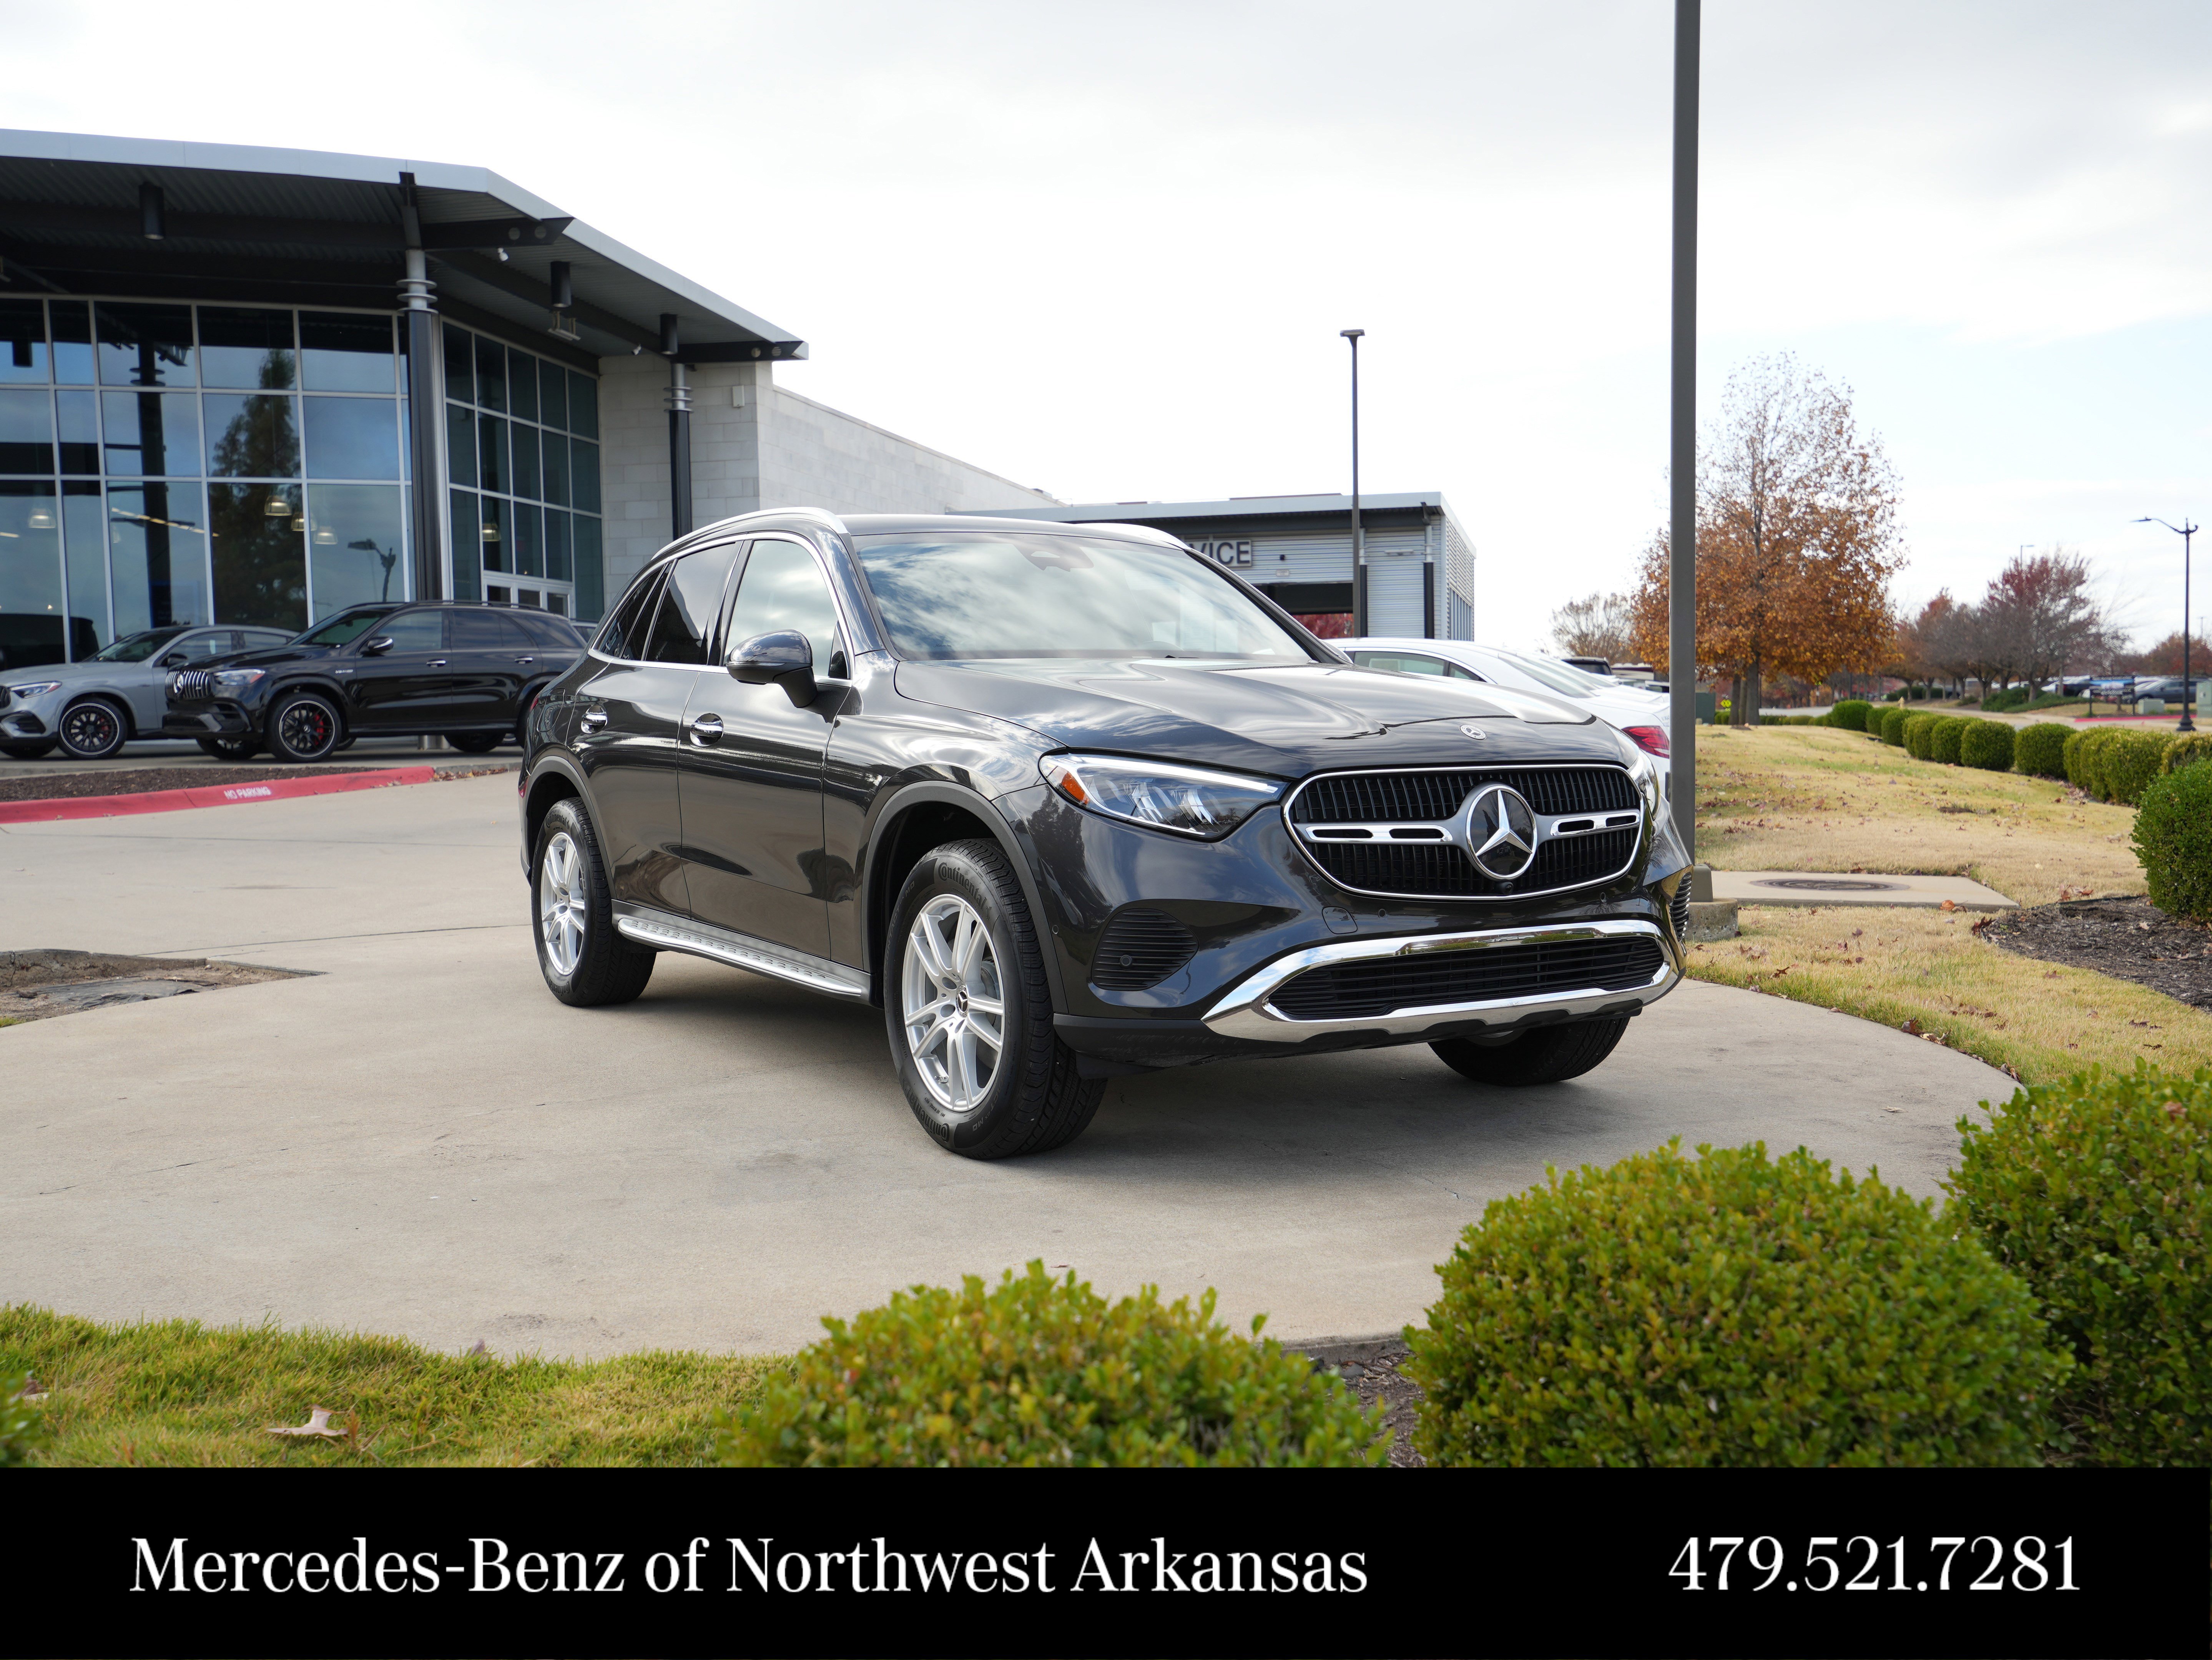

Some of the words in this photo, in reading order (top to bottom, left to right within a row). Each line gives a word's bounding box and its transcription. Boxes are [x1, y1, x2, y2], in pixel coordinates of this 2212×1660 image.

[224, 789, 238, 800] NO
[236, 786, 271, 798] PARKING
[545, 812, 567, 828] Continental
[938, 862, 987, 910] Continental
[549, 979, 570, 996] Continental
[907, 1088, 950, 1142] Continental
[972, 1117, 984, 1132] MO
